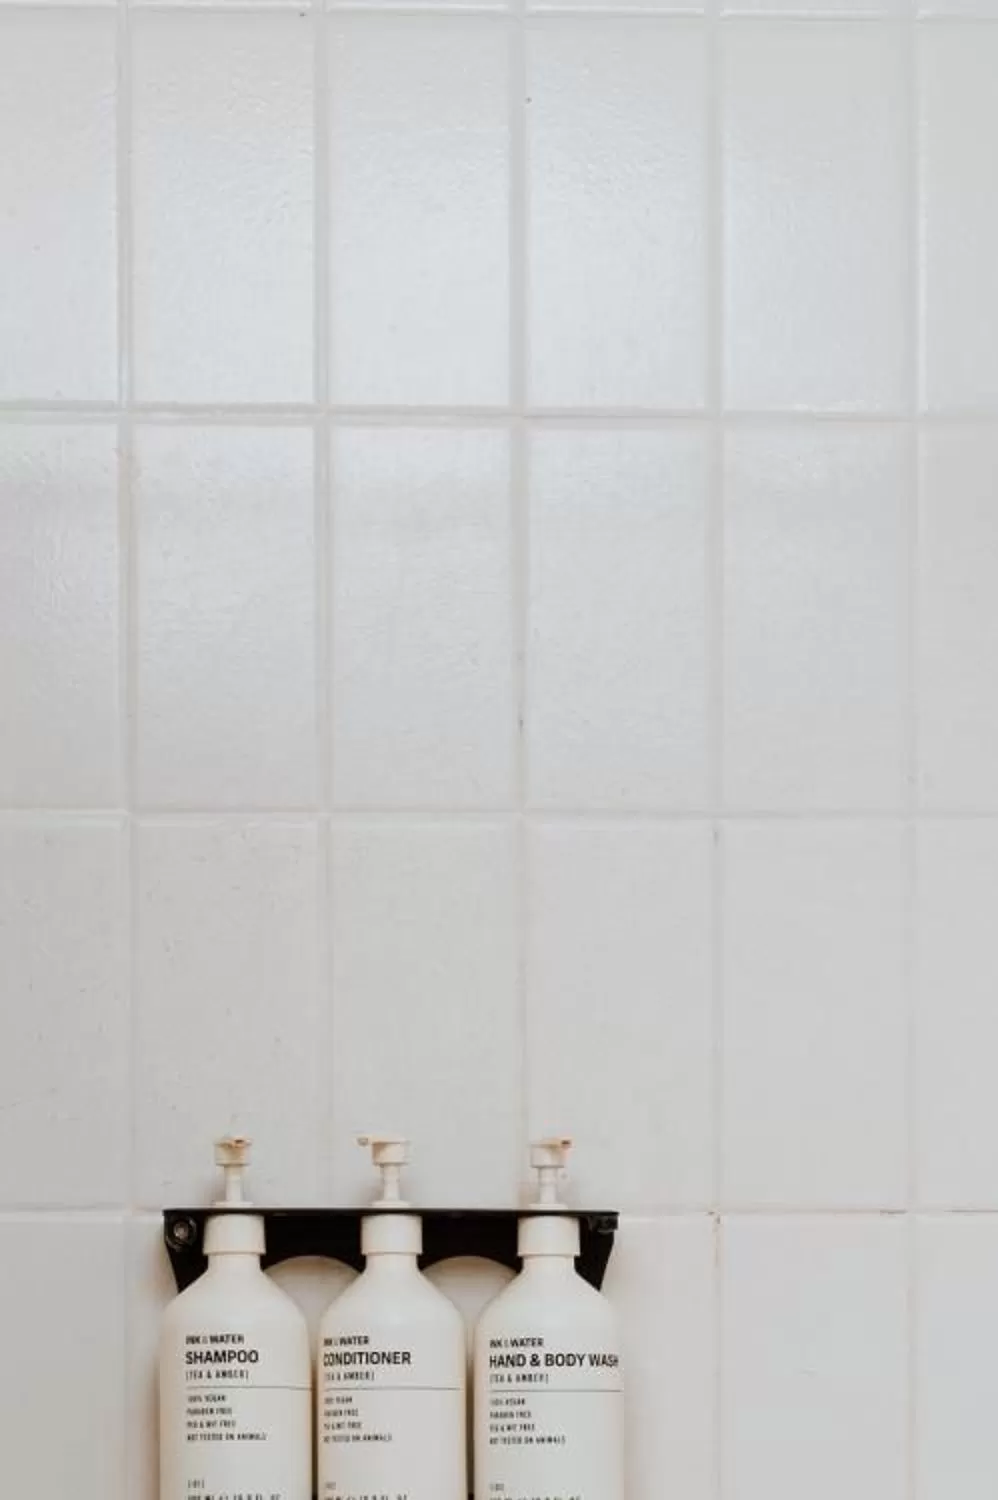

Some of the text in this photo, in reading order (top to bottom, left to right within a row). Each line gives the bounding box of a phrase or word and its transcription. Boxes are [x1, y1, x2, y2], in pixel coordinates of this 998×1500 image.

[185, 1350, 259, 1364] SHAMPOO
[323, 1351, 411, 1366] CONDITIONER
[490, 1354, 526, 1368] HAND
[529, 1353, 541, 1367] &
[545, 1353, 585, 1367] BODY
